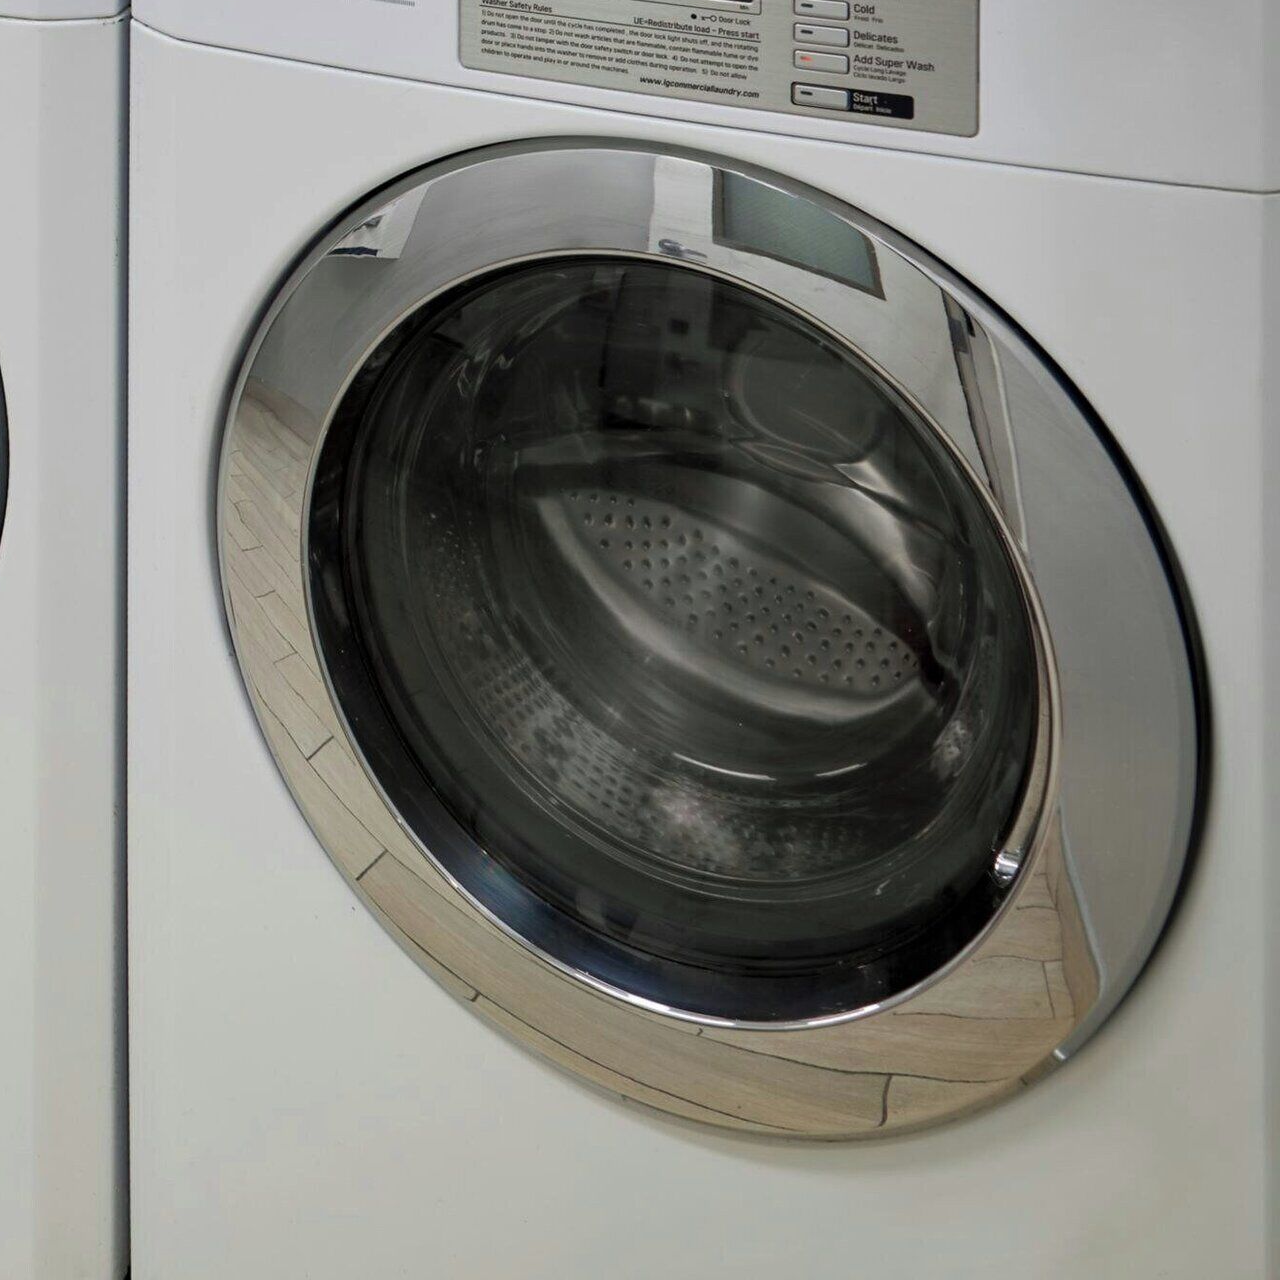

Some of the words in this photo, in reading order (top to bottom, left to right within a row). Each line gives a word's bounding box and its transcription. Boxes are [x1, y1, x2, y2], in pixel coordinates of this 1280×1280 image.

[509, 0, 531, 12] Safety
[533, 3, 552, 13] Rules
[854, 3, 875, 14] Cold
[718, 15, 735, 24] Door
[736, 18, 751, 26] Lock
[520, 13, 529, 21] the
[530, 15, 542, 23] door
[557, 18, 566, 26] the
[629, 28, 638, 36] the
[640, 30, 652, 38] door
[711, 39, 722, 47] and
[723, 41, 733, 49] the
[694, 23, 711, 34] load
[718, 27, 740, 38] Press
[741, 30, 759, 39] start
[854, 30, 898, 44] Delicates
[580, 40, 593, 49] door
[853, 55, 873, 64] Add
[875, 56, 904, 68] Super
[907, 60, 935, 72] Wash
[853, 92, 878, 104] Start
